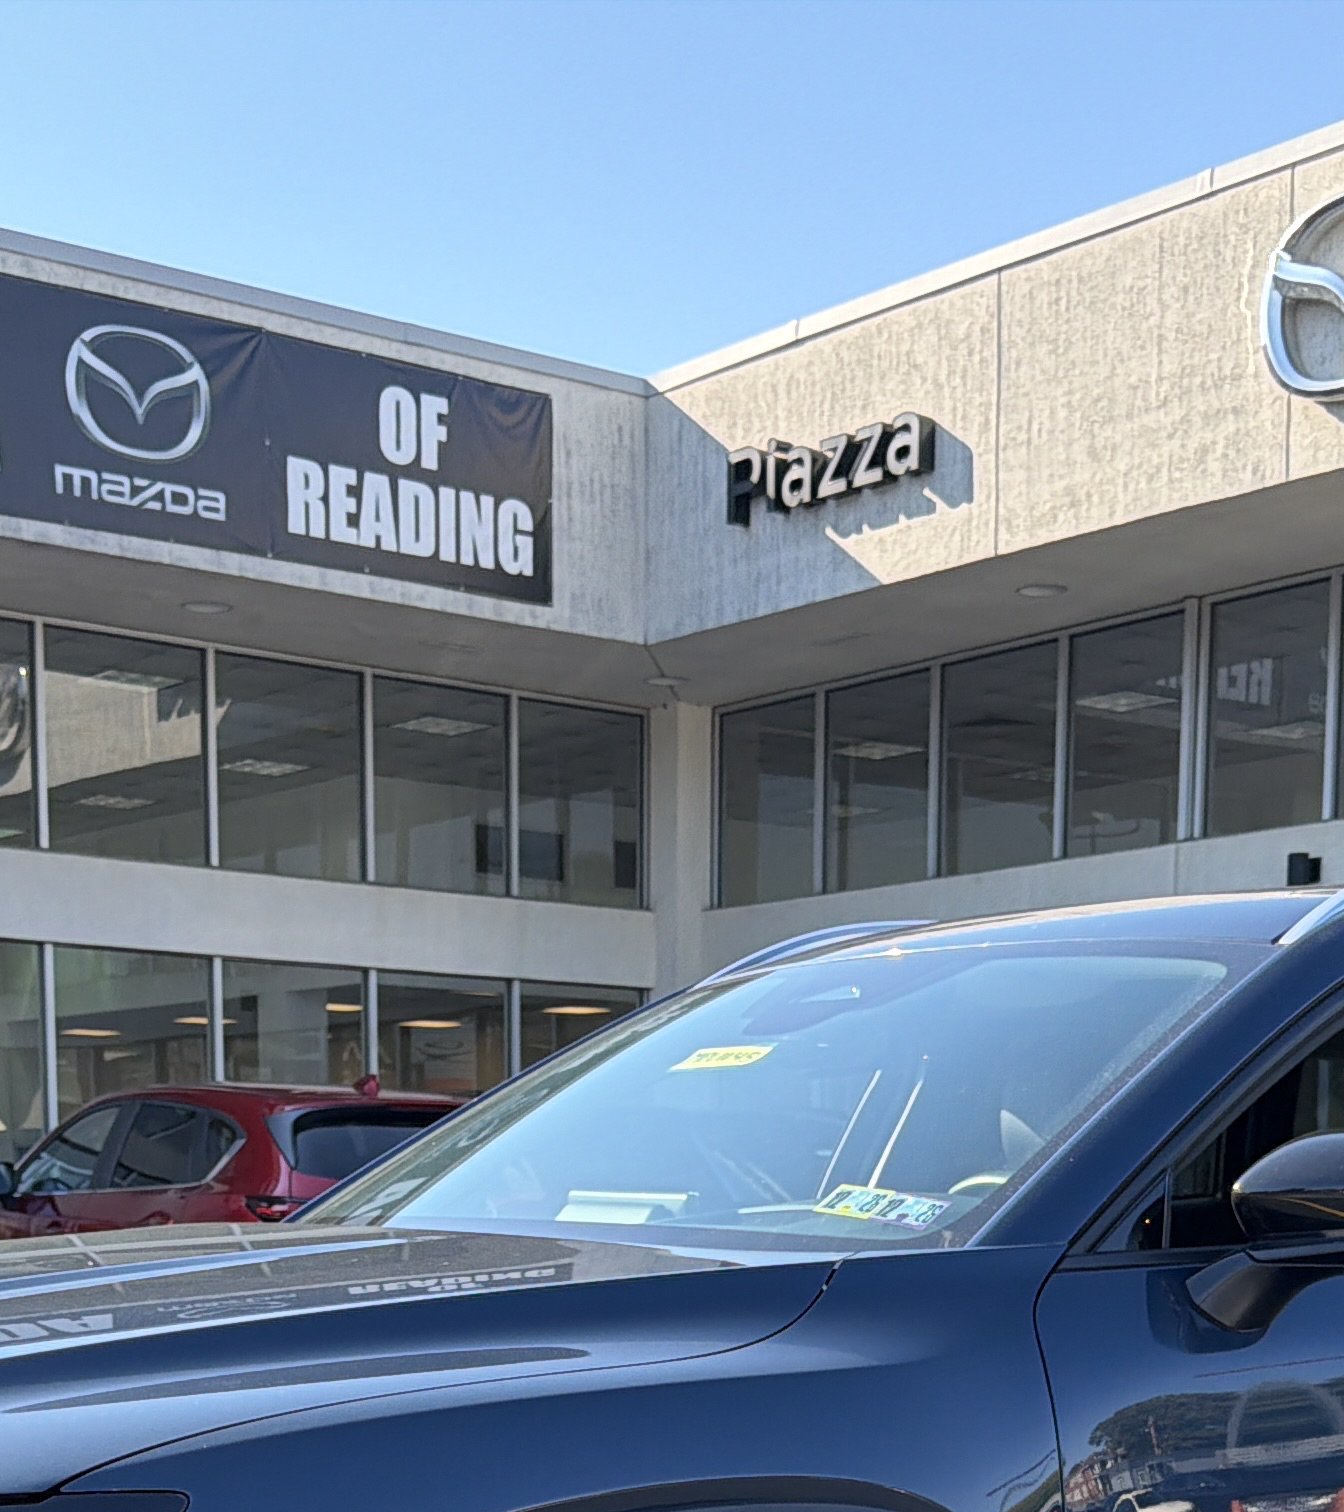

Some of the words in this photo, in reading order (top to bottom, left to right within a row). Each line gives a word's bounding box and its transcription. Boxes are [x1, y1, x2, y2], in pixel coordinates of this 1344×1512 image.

[377, 385, 449, 471] OF
[727, 411, 935, 528] Piazza
[54, 462, 227, 522] mazda
[285, 455, 535, 577] READING
